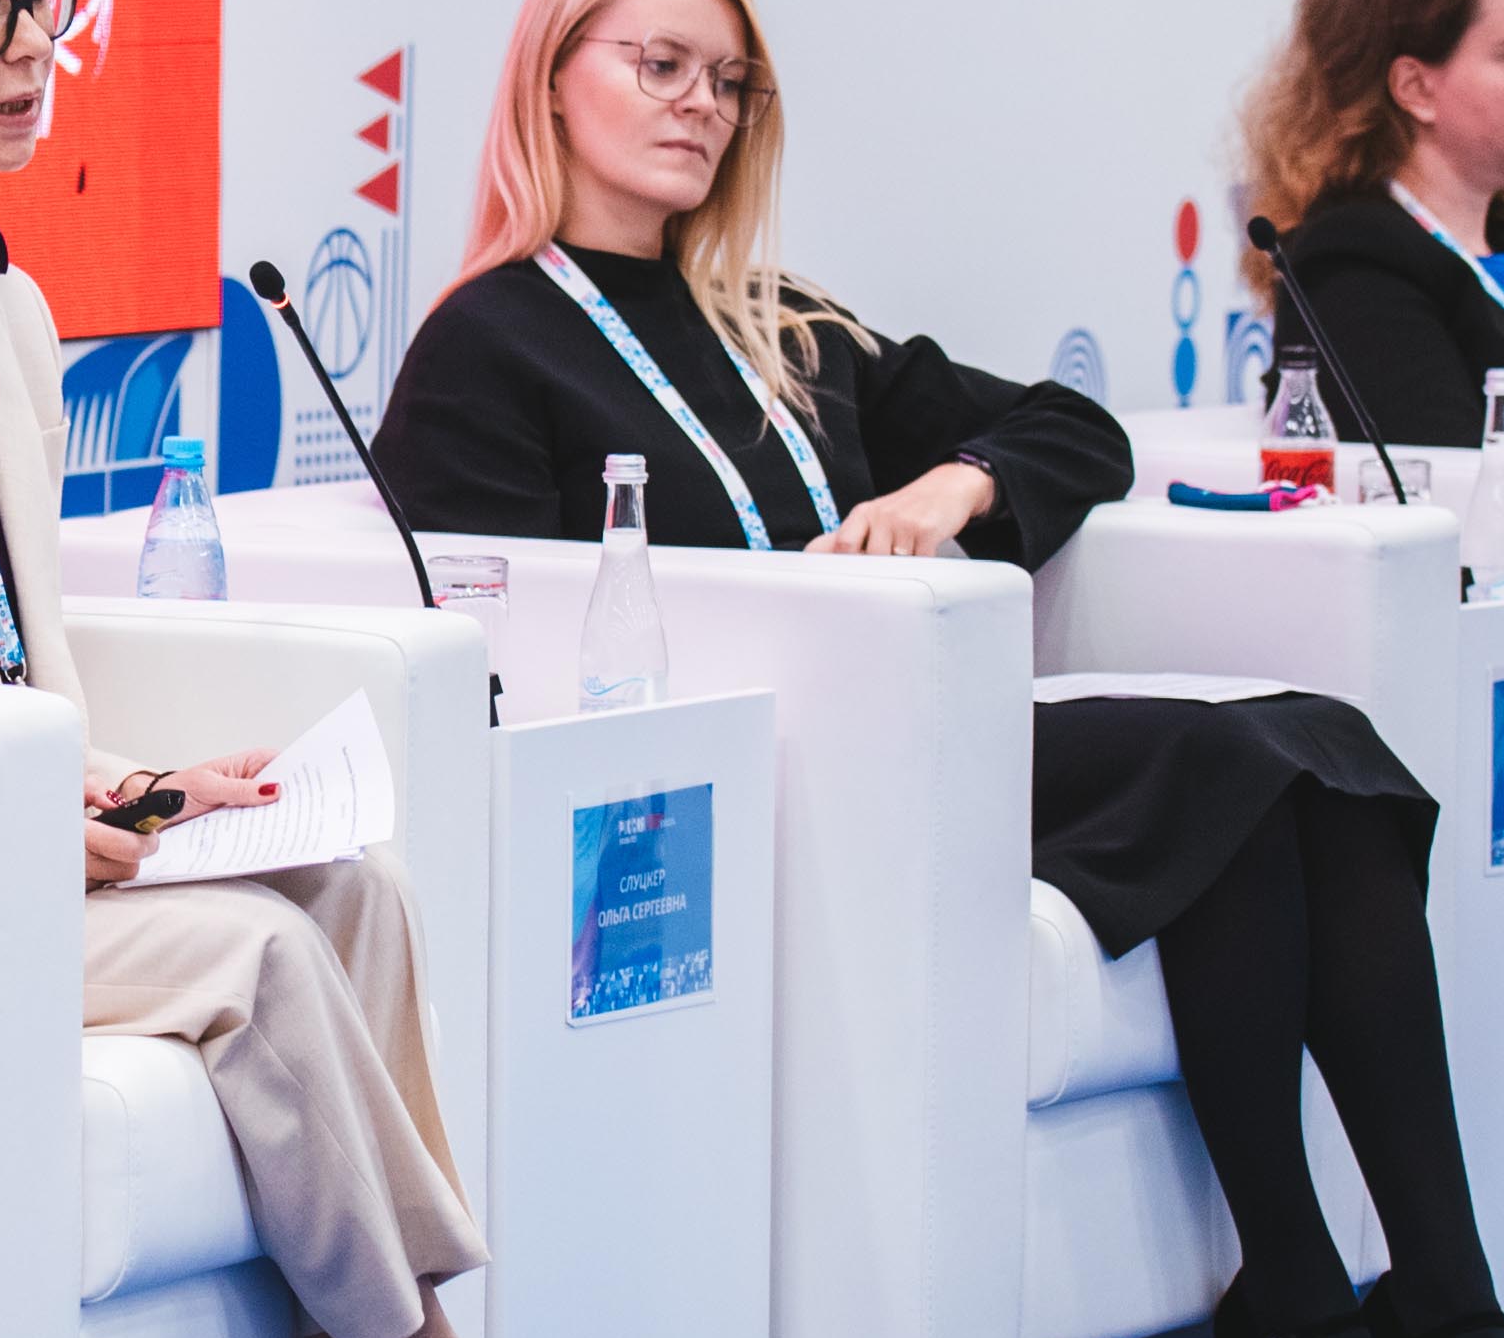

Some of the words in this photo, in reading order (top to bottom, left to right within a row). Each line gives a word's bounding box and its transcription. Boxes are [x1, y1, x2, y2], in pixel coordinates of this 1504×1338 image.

[619, 868, 666, 893] СЛУЦКЕР
[598, 906, 630, 929] ОЛЬГА
[632, 893, 687, 921] СЕРГЕЕВНА
